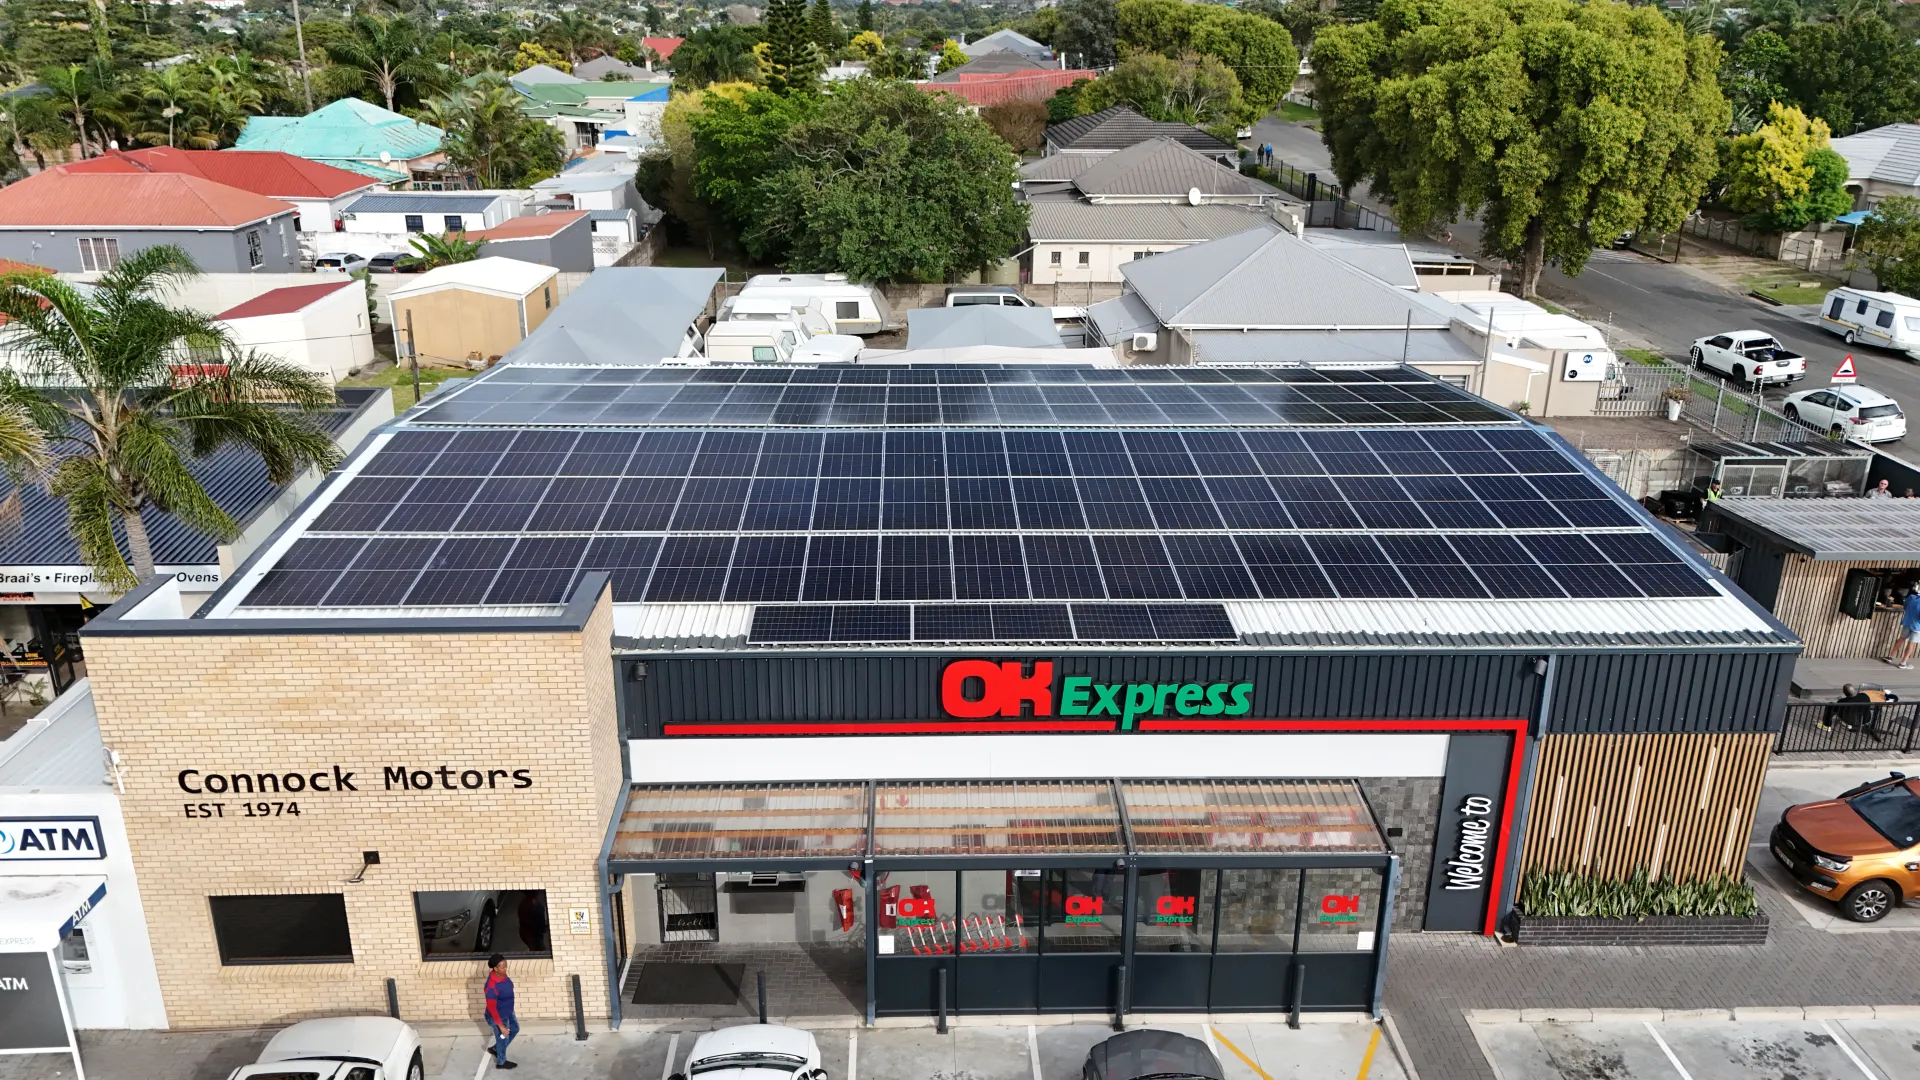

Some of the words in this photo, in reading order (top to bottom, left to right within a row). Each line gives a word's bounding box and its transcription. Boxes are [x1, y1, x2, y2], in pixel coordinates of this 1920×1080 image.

[54, 572, 108, 586] Firepla
[176, 572, 219, 583] Ovens
[942, 660, 1053, 718] OK
[1060, 676, 1253, 730] Express
[178, 765, 358, 794] Connock
[384, 765, 533, 791] Motors
[184, 803, 226, 819] EST
[243, 801, 301, 818] 1974
[1461, 796, 1492, 816] to
[19, 828, 95, 851] ATM
[1445, 819, 1490, 890] Welcome
[72, 899, 92, 928] ATM
[898, 897, 936, 917] OK
[1065, 895, 1103, 915] OK
[1156, 895, 1195, 915] OK
[1321, 894, 1360, 914] OK
[1065, 915, 1102, 925] Express
[1155, 915, 1193, 925] Express
[0, 937, 36, 945] EXPRESS
